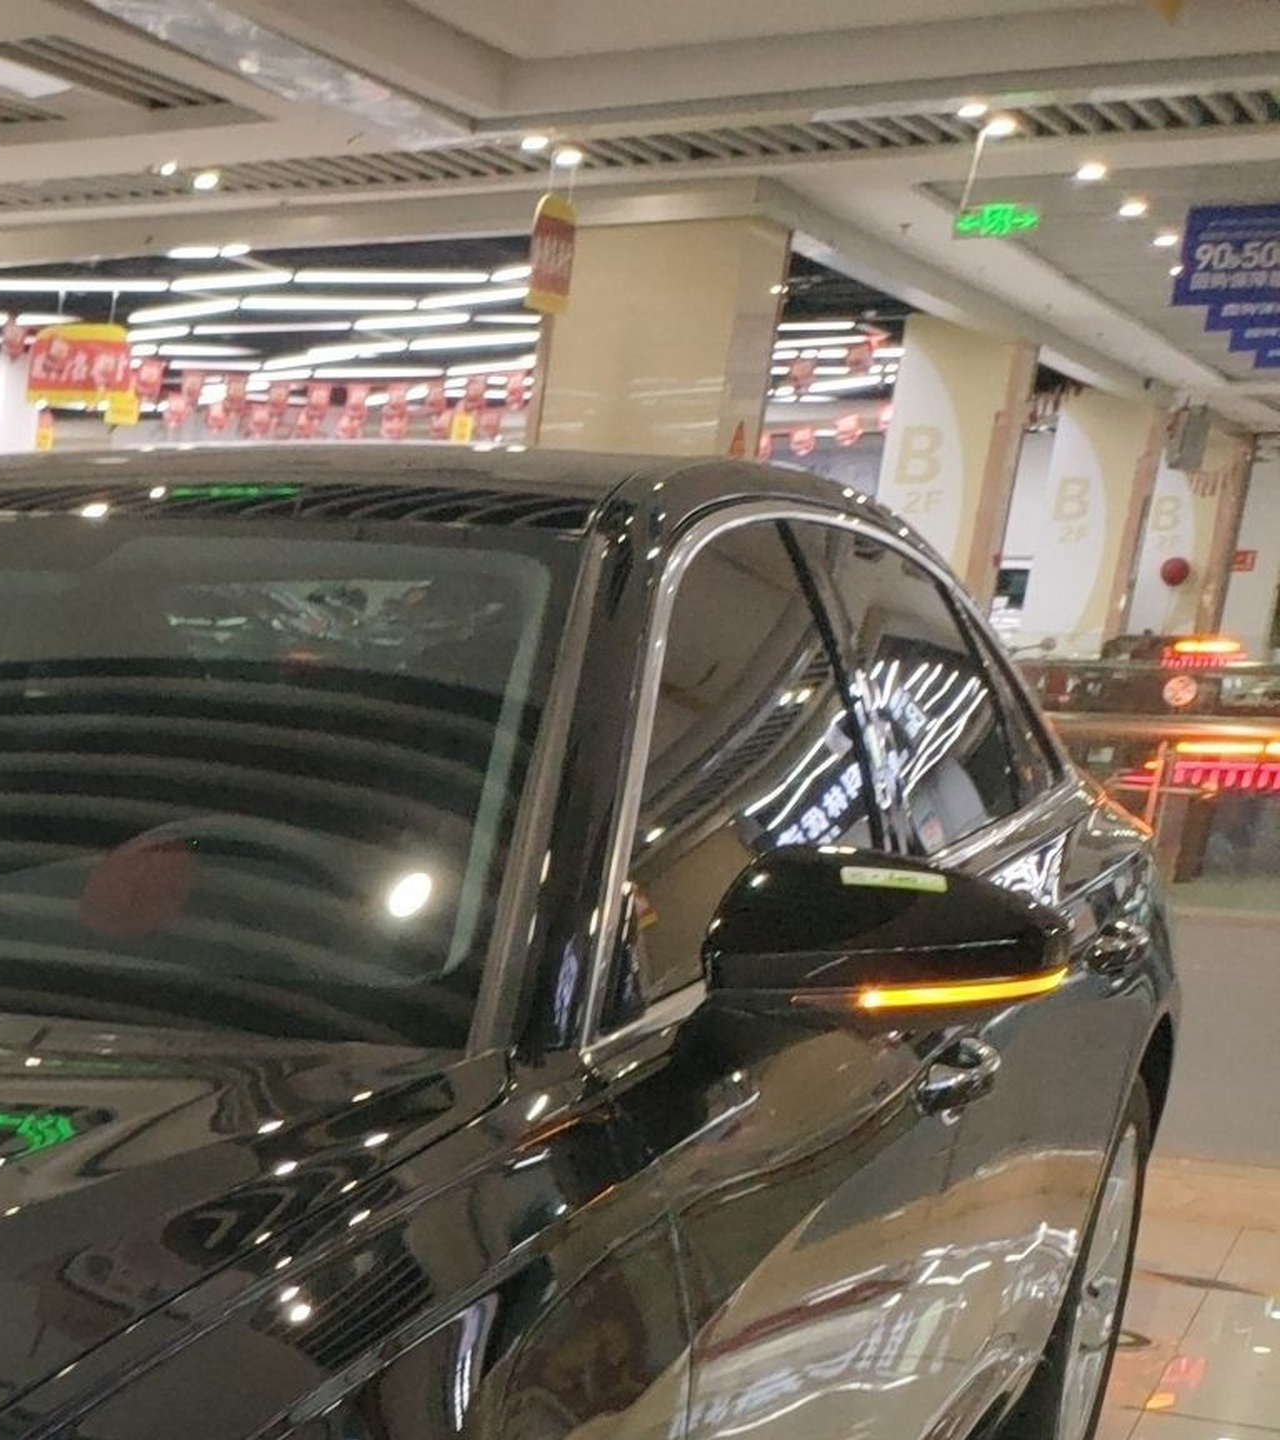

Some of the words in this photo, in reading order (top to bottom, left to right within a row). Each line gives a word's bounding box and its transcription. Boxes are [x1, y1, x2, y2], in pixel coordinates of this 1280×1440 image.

[894, 426, 943, 485] B
[903, 490, 944, 513] 2F
[1053, 477, 1091, 520] B
[1152, 496, 1182, 531] B
